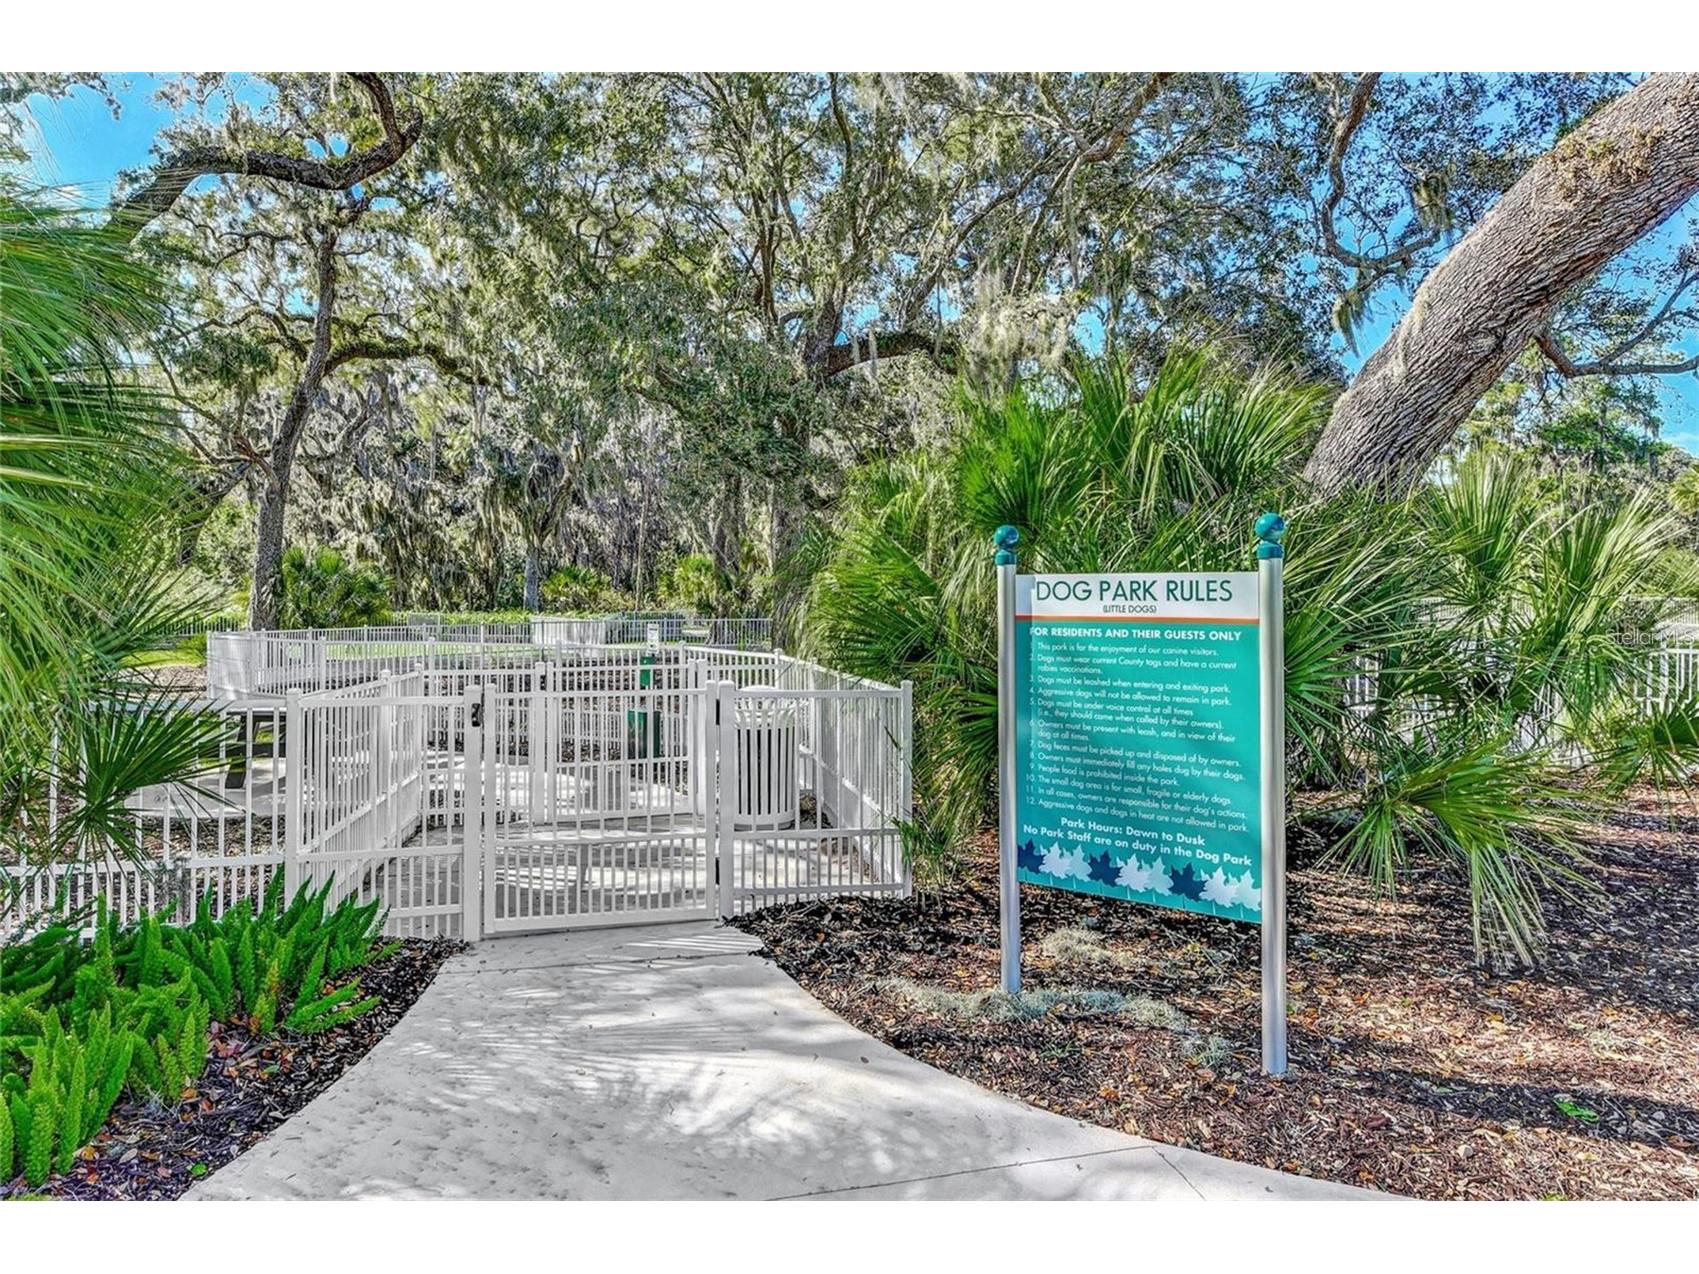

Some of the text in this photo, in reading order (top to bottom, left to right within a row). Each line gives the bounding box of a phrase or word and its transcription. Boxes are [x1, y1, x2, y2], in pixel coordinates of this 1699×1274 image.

[1036, 580, 1233, 602] DOG PARK RULES
[1103, 605, 1157, 614] (LITTLE DOGS)
[1029, 627, 1242, 641] FOR RESIDENTS AND THEIR GUESTS ONLY
[1038, 642, 1050, 650] This
[1052, 643, 1068, 652] park
[1076, 643, 1086, 651] for
[1088, 643, 1099, 651] the
[1100, 644, 1136, 654] enjoyment
[1138, 645, 1147, 654] of
[1190, 647, 1219, 656] visitors.
[1038, 654, 1054, 663] Dogs
[1092, 656, 1117, 664] current
[1118, 656, 1144, 667] County
[1146, 660, 1161, 668] tags
[1163, 658, 1178, 667] and
[1180, 658, 1199, 668] have
[1038, 675, 1054, 685] Dogs
[1073, 676, 1082, 685] be
[1084, 677, 1111, 686] leashed
[1112, 679, 1131, 687] when
[1133, 681, 1163, 691] entering
[1165, 681, 1180, 690] and
[1183, 683, 1209, 693] exiting
[1210, 684, 1231, 694] park.
[1038, 687, 1074, 696] Aggressive
[1075, 688, 1092, 698] dogs
[1121, 691, 1130, 699] be
[1132, 692, 1161, 701] allowed
[1172, 695, 1200, 703] remain
[1201, 696, 1209, 704] in
[1211, 697, 1232, 706] park.
[1038, 698, 1054, 708] Dogs
[1073, 700, 1082, 708] be
[1084, 702, 1103, 710] under
[1106, 703, 1124, 711] voice
[1126, 704, 1151, 713] control
[1162, 705, 1172, 714] all
[1054, 709, 1068, 719] they
[1070, 710, 1093, 719] should
[1115, 713, 1134, 722] when
[1136, 715, 1158, 724] called
[1160, 716, 1170, 727] by
[1171, 718, 1189, 726] their
[1191, 720, 1224, 730] owners).
[1038, 720, 1064, 729] Owners
[1082, 722, 1091, 731] be
[1121, 726, 1136, 734] with
[1137, 726, 1159, 738] leash,
[1161, 730, 1176, 738] and
[1188, 732, 1205, 740] view
[1208, 732, 1216, 741] of
[1218, 734, 1236, 742] their
[1038, 741, 1052, 751] Dog
[1089, 745, 1098, 753] be
[1100, 747, 1124, 756] picked
[1136, 750, 1152, 758] and
[1153, 751, 1186, 762] disposed
[1188, 754, 1197, 762] of
[1198, 754, 1208, 765] by
[1210, 759, 1241, 767] owners.
[1038, 752, 1063, 762] Owners
[1137, 765, 1150, 773] any
[1152, 762, 1172, 773] holes
[1174, 766, 1190, 776] dog
[1191, 766, 1201, 777] by
[1203, 768, 1221, 777] their
[1223, 770, 1245, 782] dogs.
[1038, 764, 1179, 786] People food prohibited inside the park.
[1039, 775, 1050, 784] The
[1052, 777, 1068, 785] small
[1070, 779, 1084, 789] dog
[1111, 782, 1121, 791] for
[1183, 791, 1209, 803] elderly
[1046, 787, 1054, 795] all
[1056, 791, 1076, 799] cases,
[1078, 794, 1103, 802] owners
[1119, 798, 1159, 808] responsible
[1161, 800, 1171, 810] for
[1174, 803, 1192, 812] their
[1193, 805, 1215, 816] dog's
[1217, 809, 1247, 819] actions.
[1038, 799, 1074, 810] Aggressive
[1076, 804, 1093, 814] dogs
[1095, 806, 1108, 814] and
[1110, 808, 1128, 818] dogs
[1138, 811, 1154, 820] heat
[1156, 814, 1169, 822] are
[1186, 817, 1216, 828] allowed
[1228, 824, 1248, 832] park.
[1061, 817, 1206, 846] Park Hours: Dawn to Dusk
[1023, 824, 1252, 866] No Park Staff are on duty in the Dog Park
